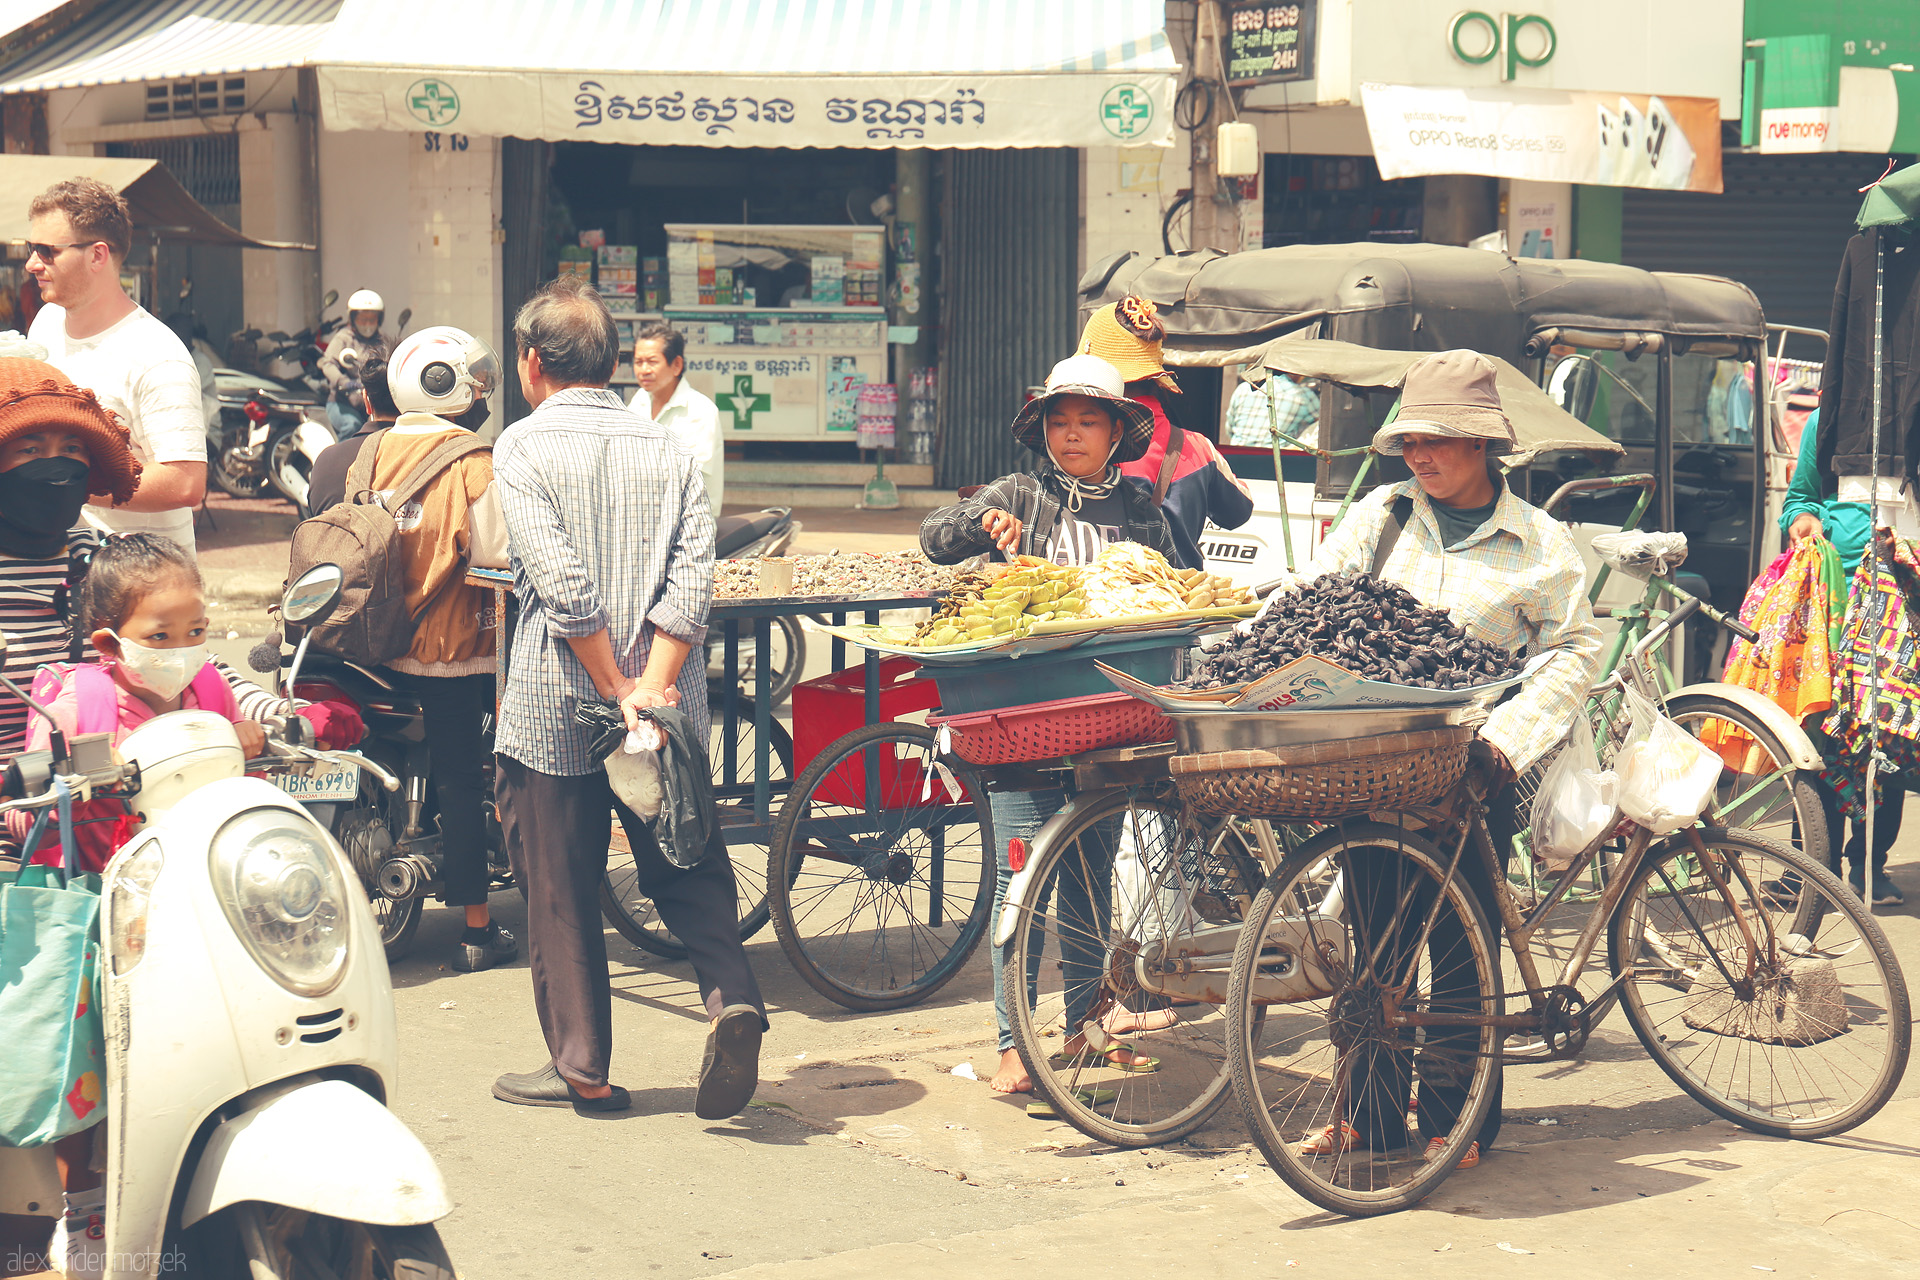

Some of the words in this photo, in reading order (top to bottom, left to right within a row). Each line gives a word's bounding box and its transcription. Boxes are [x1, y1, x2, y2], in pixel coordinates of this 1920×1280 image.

[1446, 10, 1557, 82] op
[1272, 49, 1298, 70] 24H
[1409, 130, 1451, 147] OPPO
[1455, 131, 1499, 150] Reno8
[1502, 134, 1543, 152] Series
[1792, 121, 1830, 143] money
[1196, 542, 1259, 561] xima
